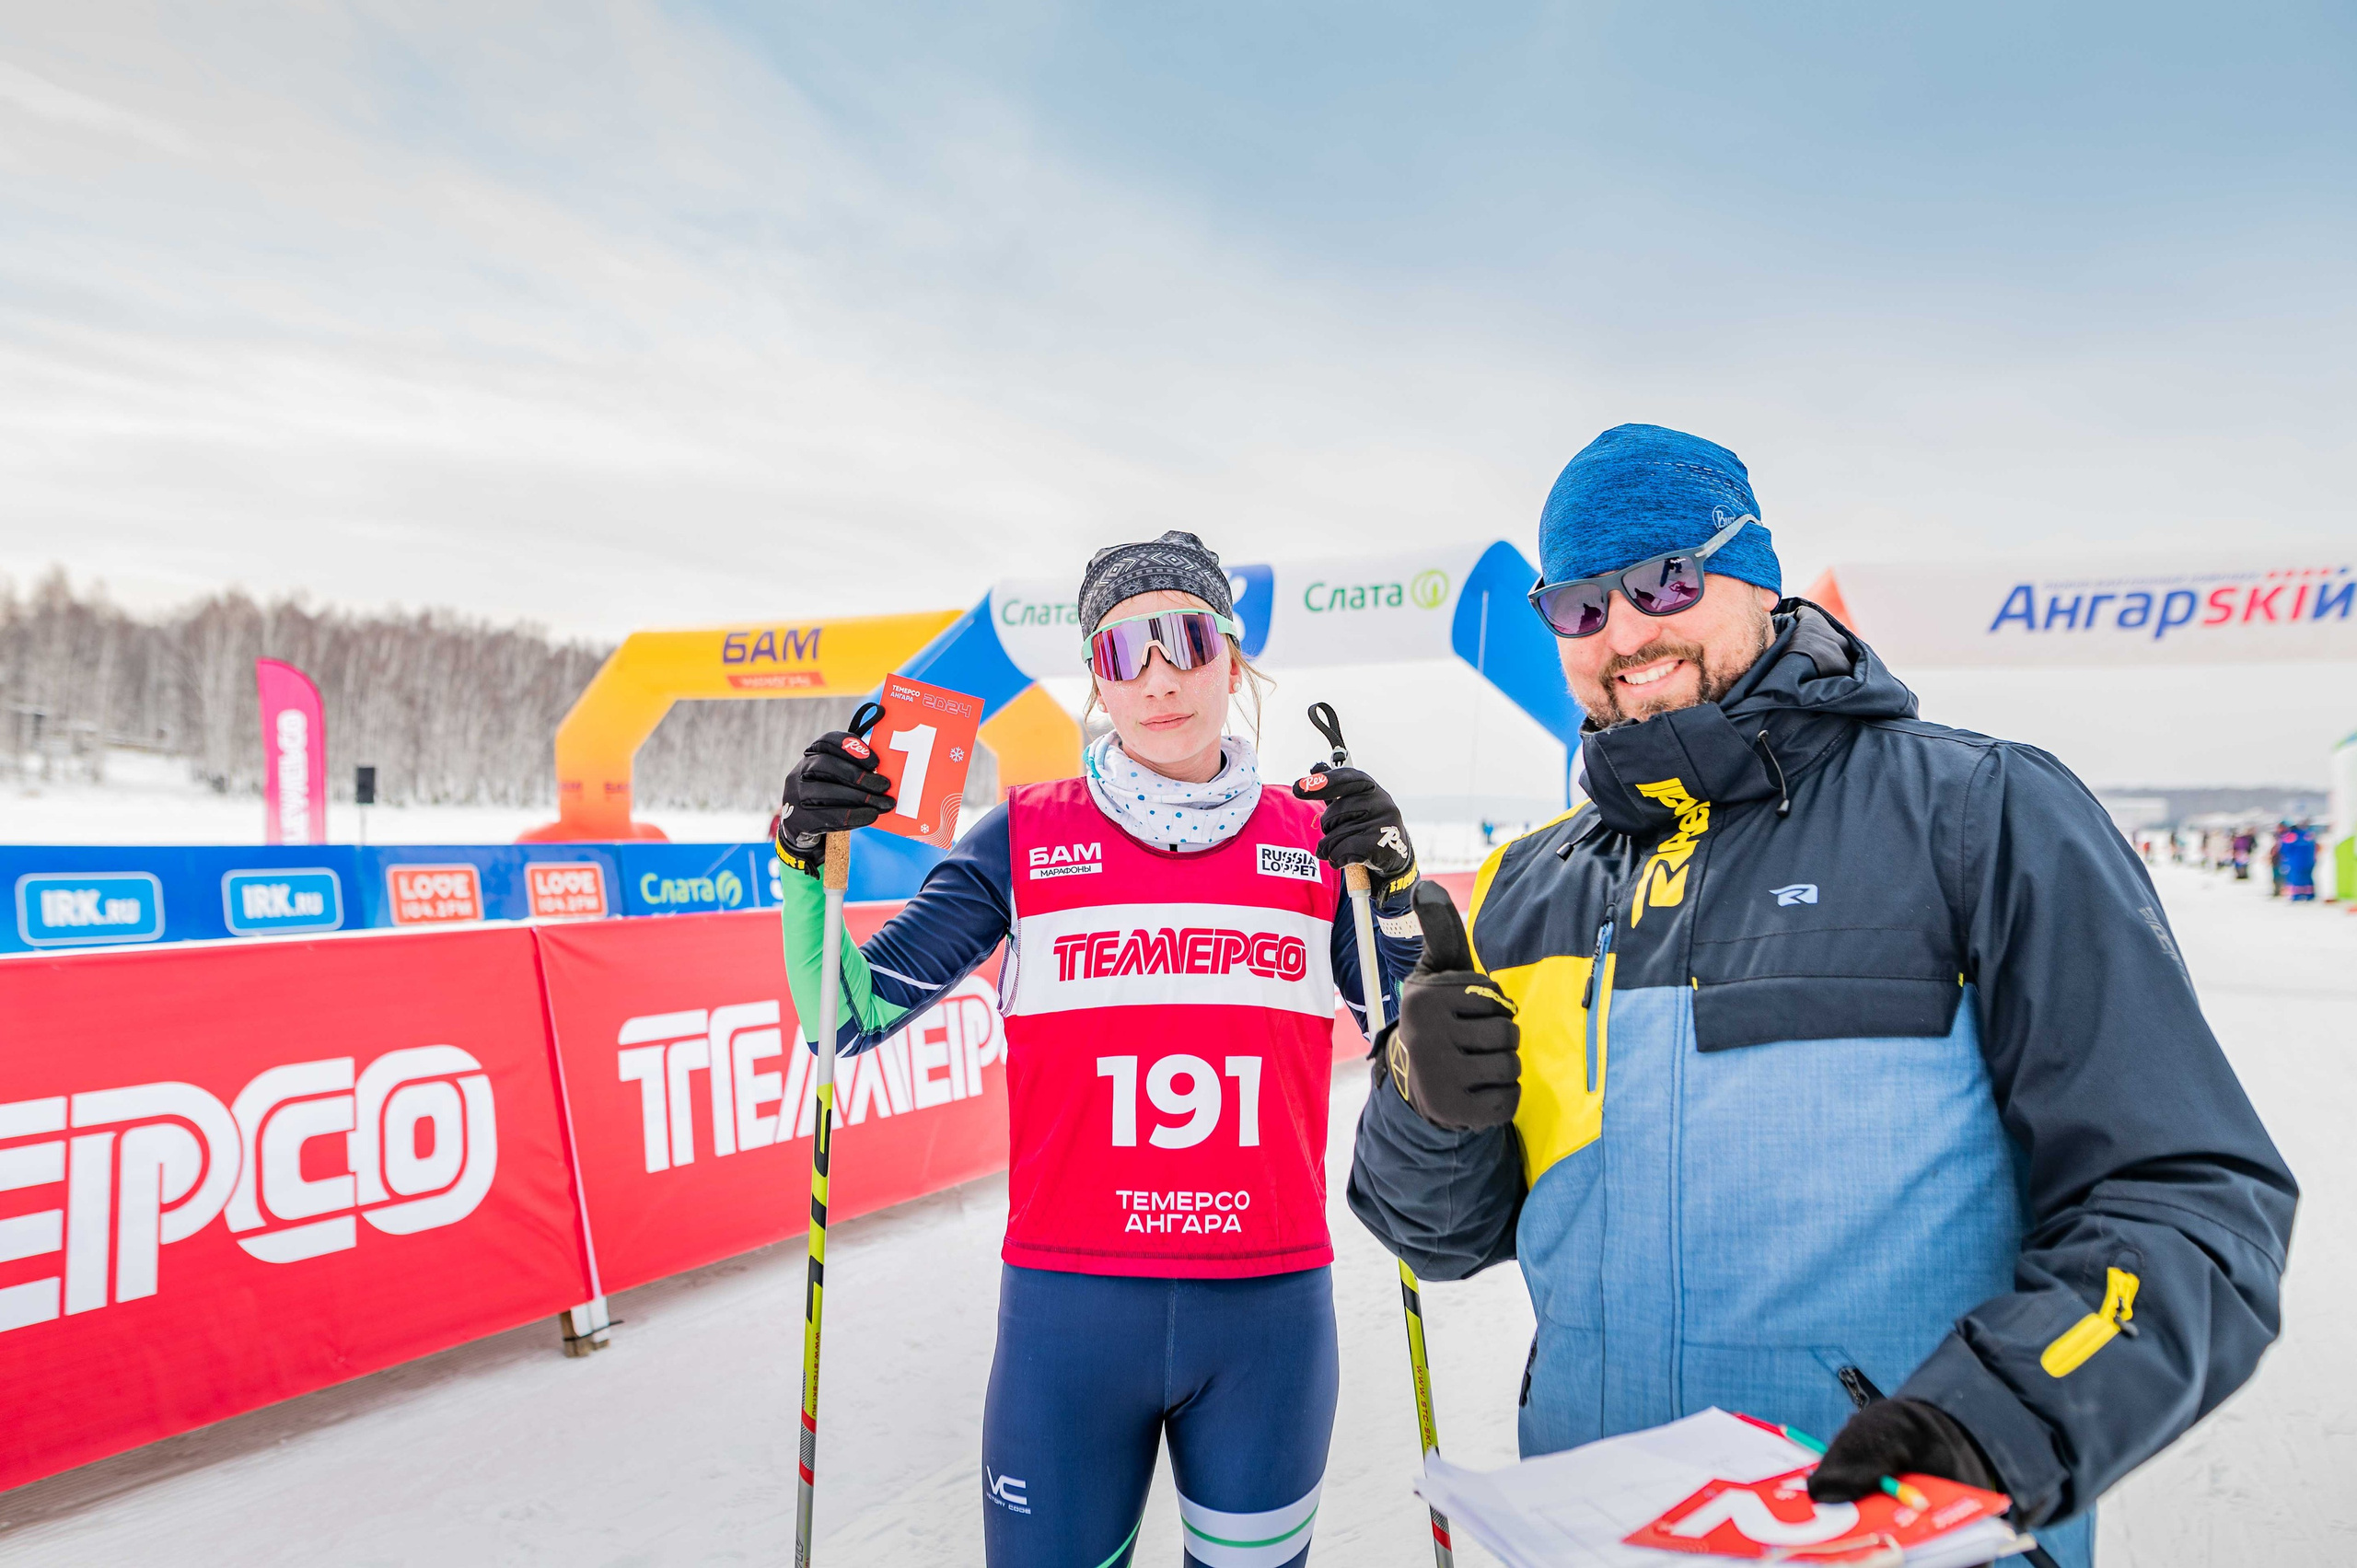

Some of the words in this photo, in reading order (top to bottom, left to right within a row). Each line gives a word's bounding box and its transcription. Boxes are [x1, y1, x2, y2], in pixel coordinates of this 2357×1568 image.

[1305, 577, 1403, 613] Слата
[723, 629, 822, 664] БАМ
[890, 691, 913, 703] АНГАРА
[892, 684, 921, 697] ТЕМЕРСО
[922, 693, 972, 717] 2024
[844, 738, 869, 756] Rex
[888, 723, 937, 819] 1
[1303, 773, 1327, 790] Rex
[1028, 842, 1102, 866] БАМ
[1262, 848, 1317, 866] RUSSIA
[1040, 865, 1091, 877] МАРАФОНЫ
[1262, 860, 1318, 877] LOPPET
[640, 873, 714, 905] Слата
[1053, 927, 1306, 981] ТЕМЕРСО
[1096, 1053, 1263, 1150] 191
[1115, 1191, 1250, 1211] ТЕМЕРСО
[1124, 1213, 1242, 1234] АНГАРА
